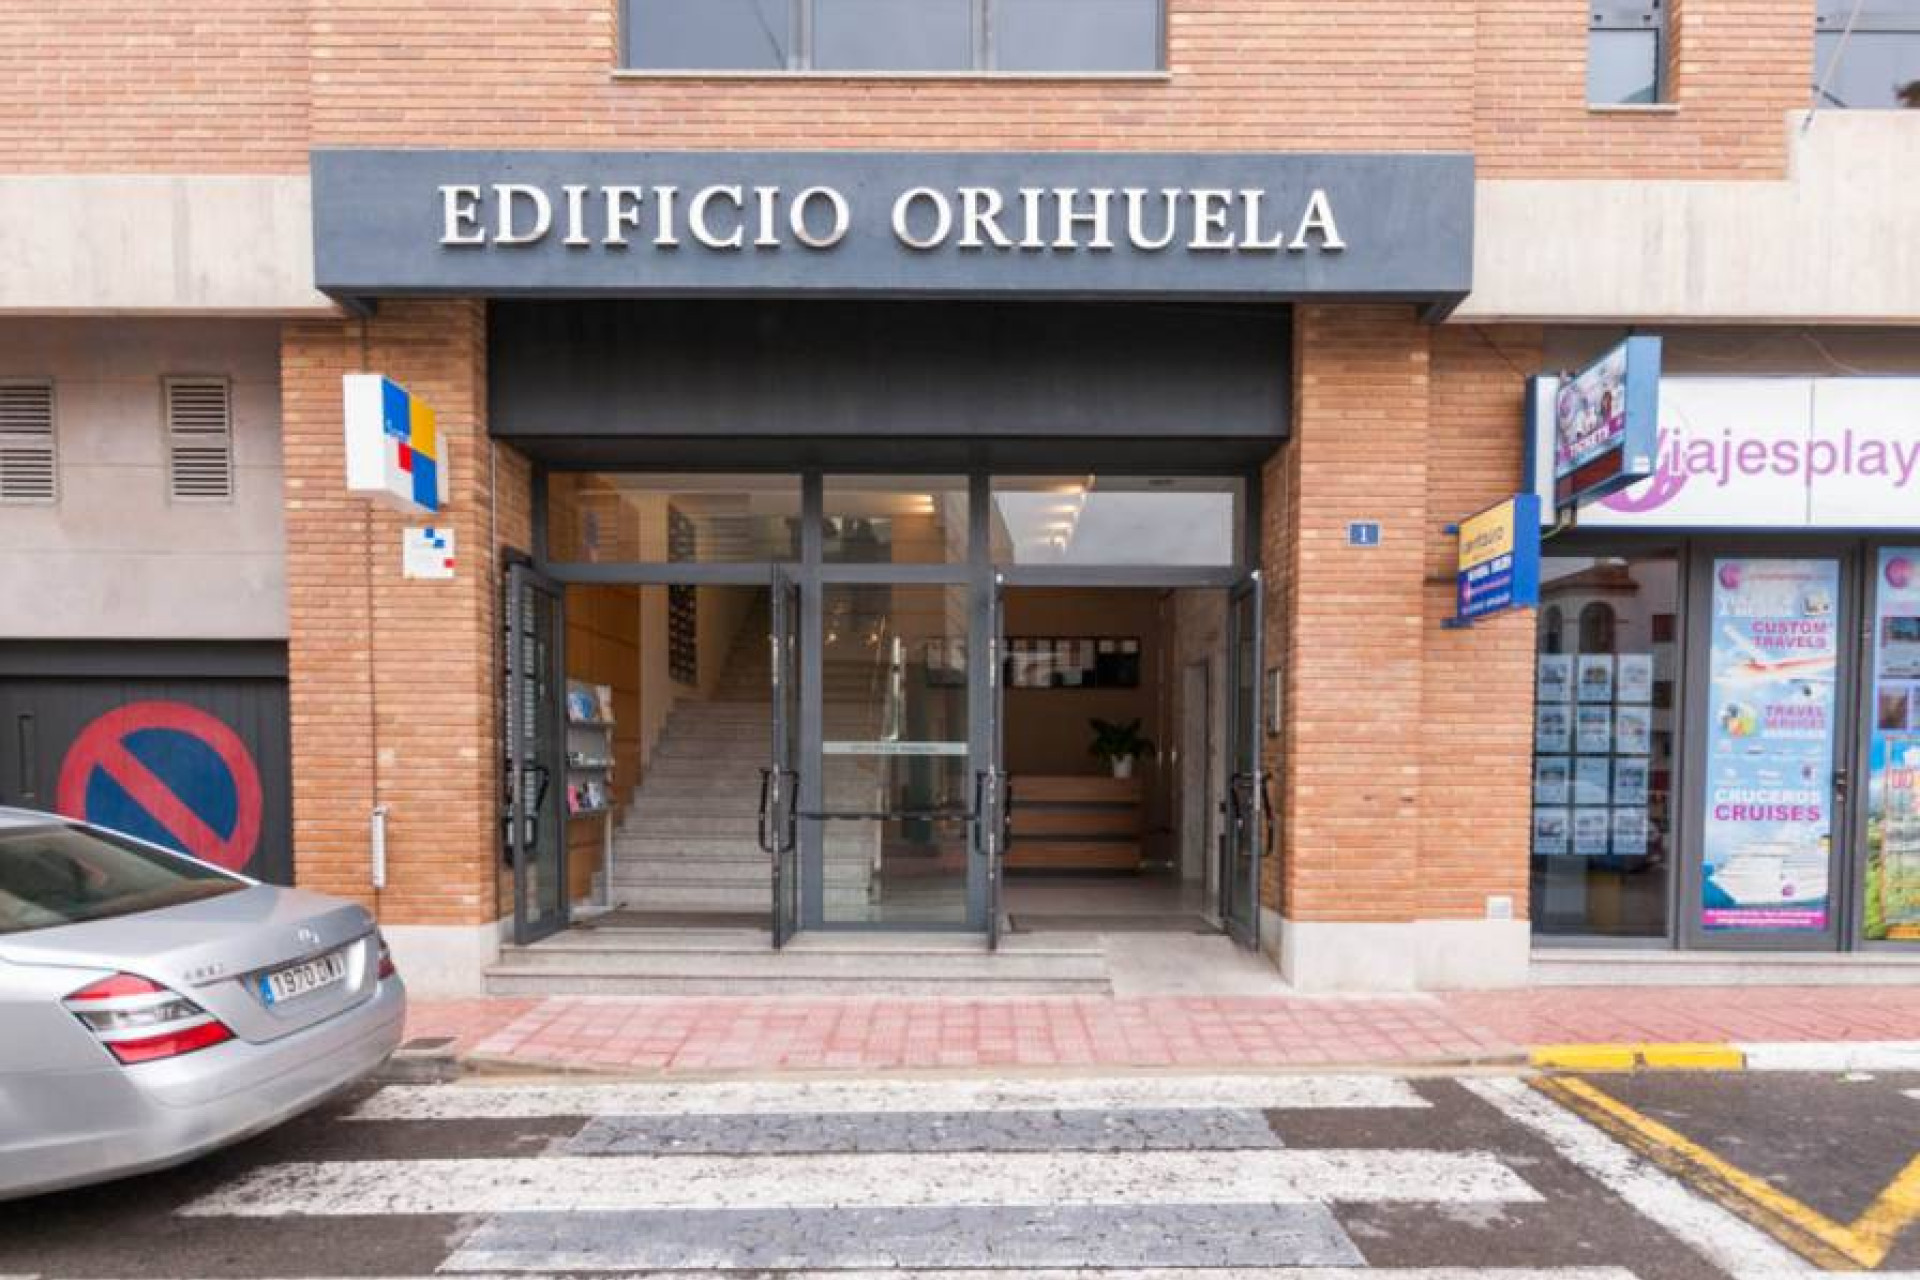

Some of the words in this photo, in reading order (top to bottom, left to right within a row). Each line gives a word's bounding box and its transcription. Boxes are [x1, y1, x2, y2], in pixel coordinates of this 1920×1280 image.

[438, 183, 850, 249] EDIFICIO
[891, 186, 1347, 251] ORIHUELA
[1751, 620, 1828, 634] CUSTOM
[1751, 635, 1827, 648] TRAVELS
[1765, 704, 1825, 717] TRAVEL
[1714, 804, 1820, 821] CRUISES
